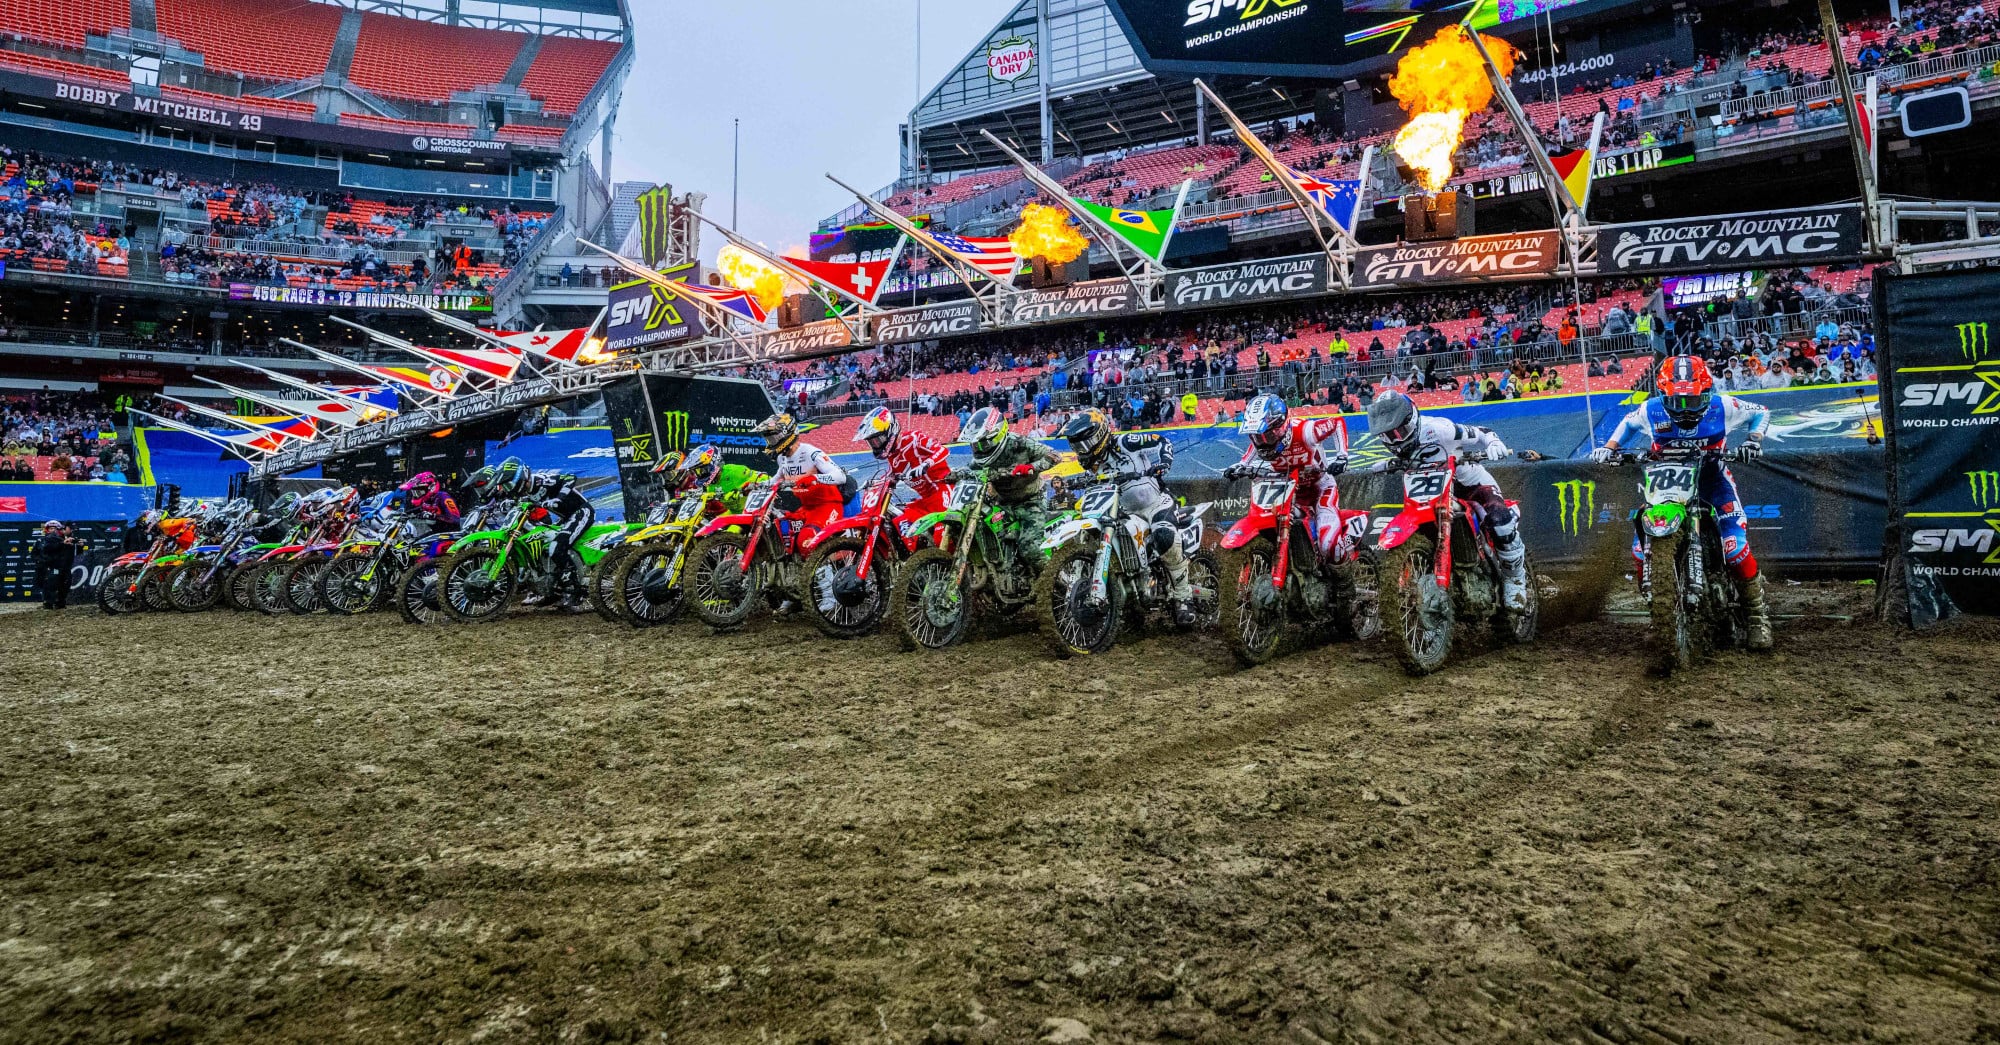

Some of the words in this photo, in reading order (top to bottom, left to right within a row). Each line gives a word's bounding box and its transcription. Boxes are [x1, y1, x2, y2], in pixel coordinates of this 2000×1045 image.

[1185, 31, 1222, 48] WORLD
[1224, 5, 1308, 37] CHAMPIONSHIP
[988, 49, 1034, 68] CANADA
[1000, 62, 1023, 76] DRY
[56, 83, 120, 107] BOBBY
[134, 97, 231, 127] MITCHELL
[239, 114, 262, 131] 49
[430, 138, 506, 150] CROSSCOUNTRY
[431, 146, 471, 154] MORTGAGE
[1489, 180, 1505, 197] 12
[1621, 156, 1629, 173] 1
[1634, 149, 1663, 171] LAP
[1646, 225, 1714, 243] ROCKY
[1716, 213, 1841, 238] MOUNTAIN
[1391, 246, 1446, 262] ROCKY
[1447, 236, 1545, 256] MOUNTAIN
[1194, 270, 1239, 285] ROCKY
[1239, 259, 1315, 278] MOUNTAIN
[1675, 278, 1702, 295] 450
[1705, 273, 1740, 292] RACE
[1743, 271, 1753, 287] 3
[252, 285, 277, 301] 450
[282, 289, 313, 304] RACE
[317, 290, 325, 304] 3
[339, 291, 351, 306] 12
[443, 296, 449, 310] 1
[452, 296, 472, 310] LAP
[608, 276, 688, 330] SMX
[1031, 291, 1065, 304] ROCKY
[1065, 284, 1129, 299] MOUNTAIN
[892, 312, 921, 325] ROCKY
[921, 306, 972, 320] MOUNTAIN
[608, 337, 632, 350] WORLD
[632, 326, 688, 345] CHAMPIONSHIP
[777, 330, 801, 342] ROCKY
[801, 324, 846, 337] MOUNTAIN
[711, 416, 757, 427] MONSTER
[1902, 419, 1949, 428] WORLD
[1409, 475, 1445, 499] 28
[1648, 469, 1693, 493] 784
[746, 492, 766, 512] 15
[863, 491, 880, 508] 96
[1082, 490, 1115, 512] 27
[1257, 483, 1290, 506] 17
[1350, 517, 1362, 535] 17
[1913, 566, 1959, 575] WORLD
